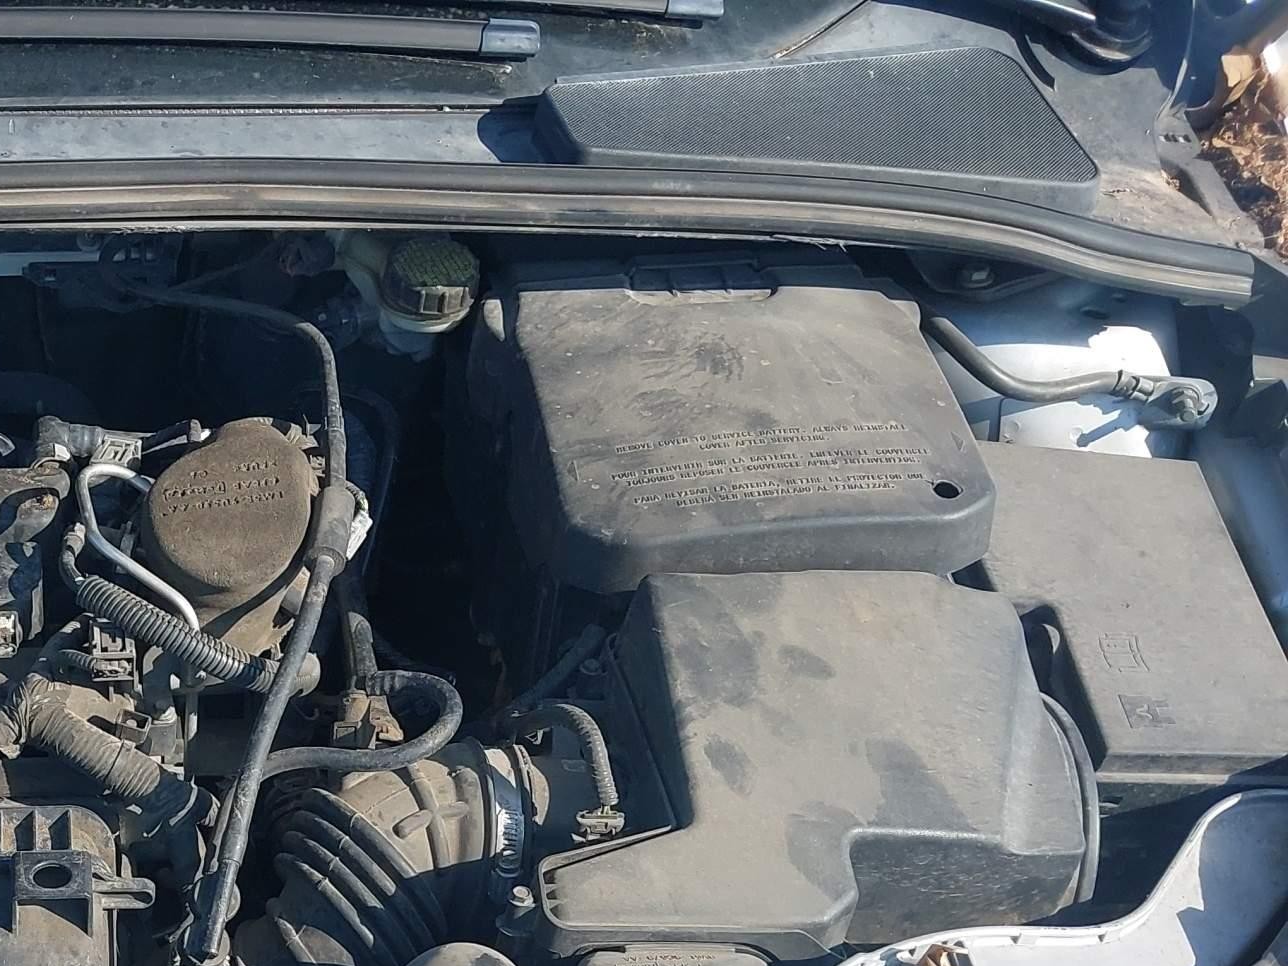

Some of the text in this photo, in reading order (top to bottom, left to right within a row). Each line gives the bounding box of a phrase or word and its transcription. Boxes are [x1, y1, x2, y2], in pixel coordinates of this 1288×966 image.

[616, 441, 654, 454] REMOVE
[658, 437, 689, 448] COVER
[694, 434, 707, 443] TO
[711, 430, 754, 441] SERVICE
[812, 424, 849, 433] ALWAYS
[853, 423, 908, 432] REINSTALL
[699, 441, 730, 451] COVER
[735, 437, 766, 447] AFTER
[611, 470, 637, 481] POUR
[641, 462, 703, 475] INTERVENIR
[708, 458, 727, 467] SUR
[732, 457, 745, 465] LA
[809, 449, 853, 459] ENLEVER
[875, 448, 929, 456] COUVERCLE
[626, 473, 676, 487] TOUJOURS
[680, 468, 724, 479] REPOSER
[728, 465, 742, 473] LE
[747, 461, 801, 472] COUVERCLE
[633, 494, 661, 505] PARA
[664, 487, 709, 499] REVISAR
[713, 483, 728, 492] LA
[785, 477, 823, 487] RETIRE
[828, 475, 842, 483] EL
[846, 472, 902, 482] PROTECTOR
[718, 492, 739, 501] SER
[743, 486, 812, 499] REINSTALADO
[816, 484, 831, 493] AL
